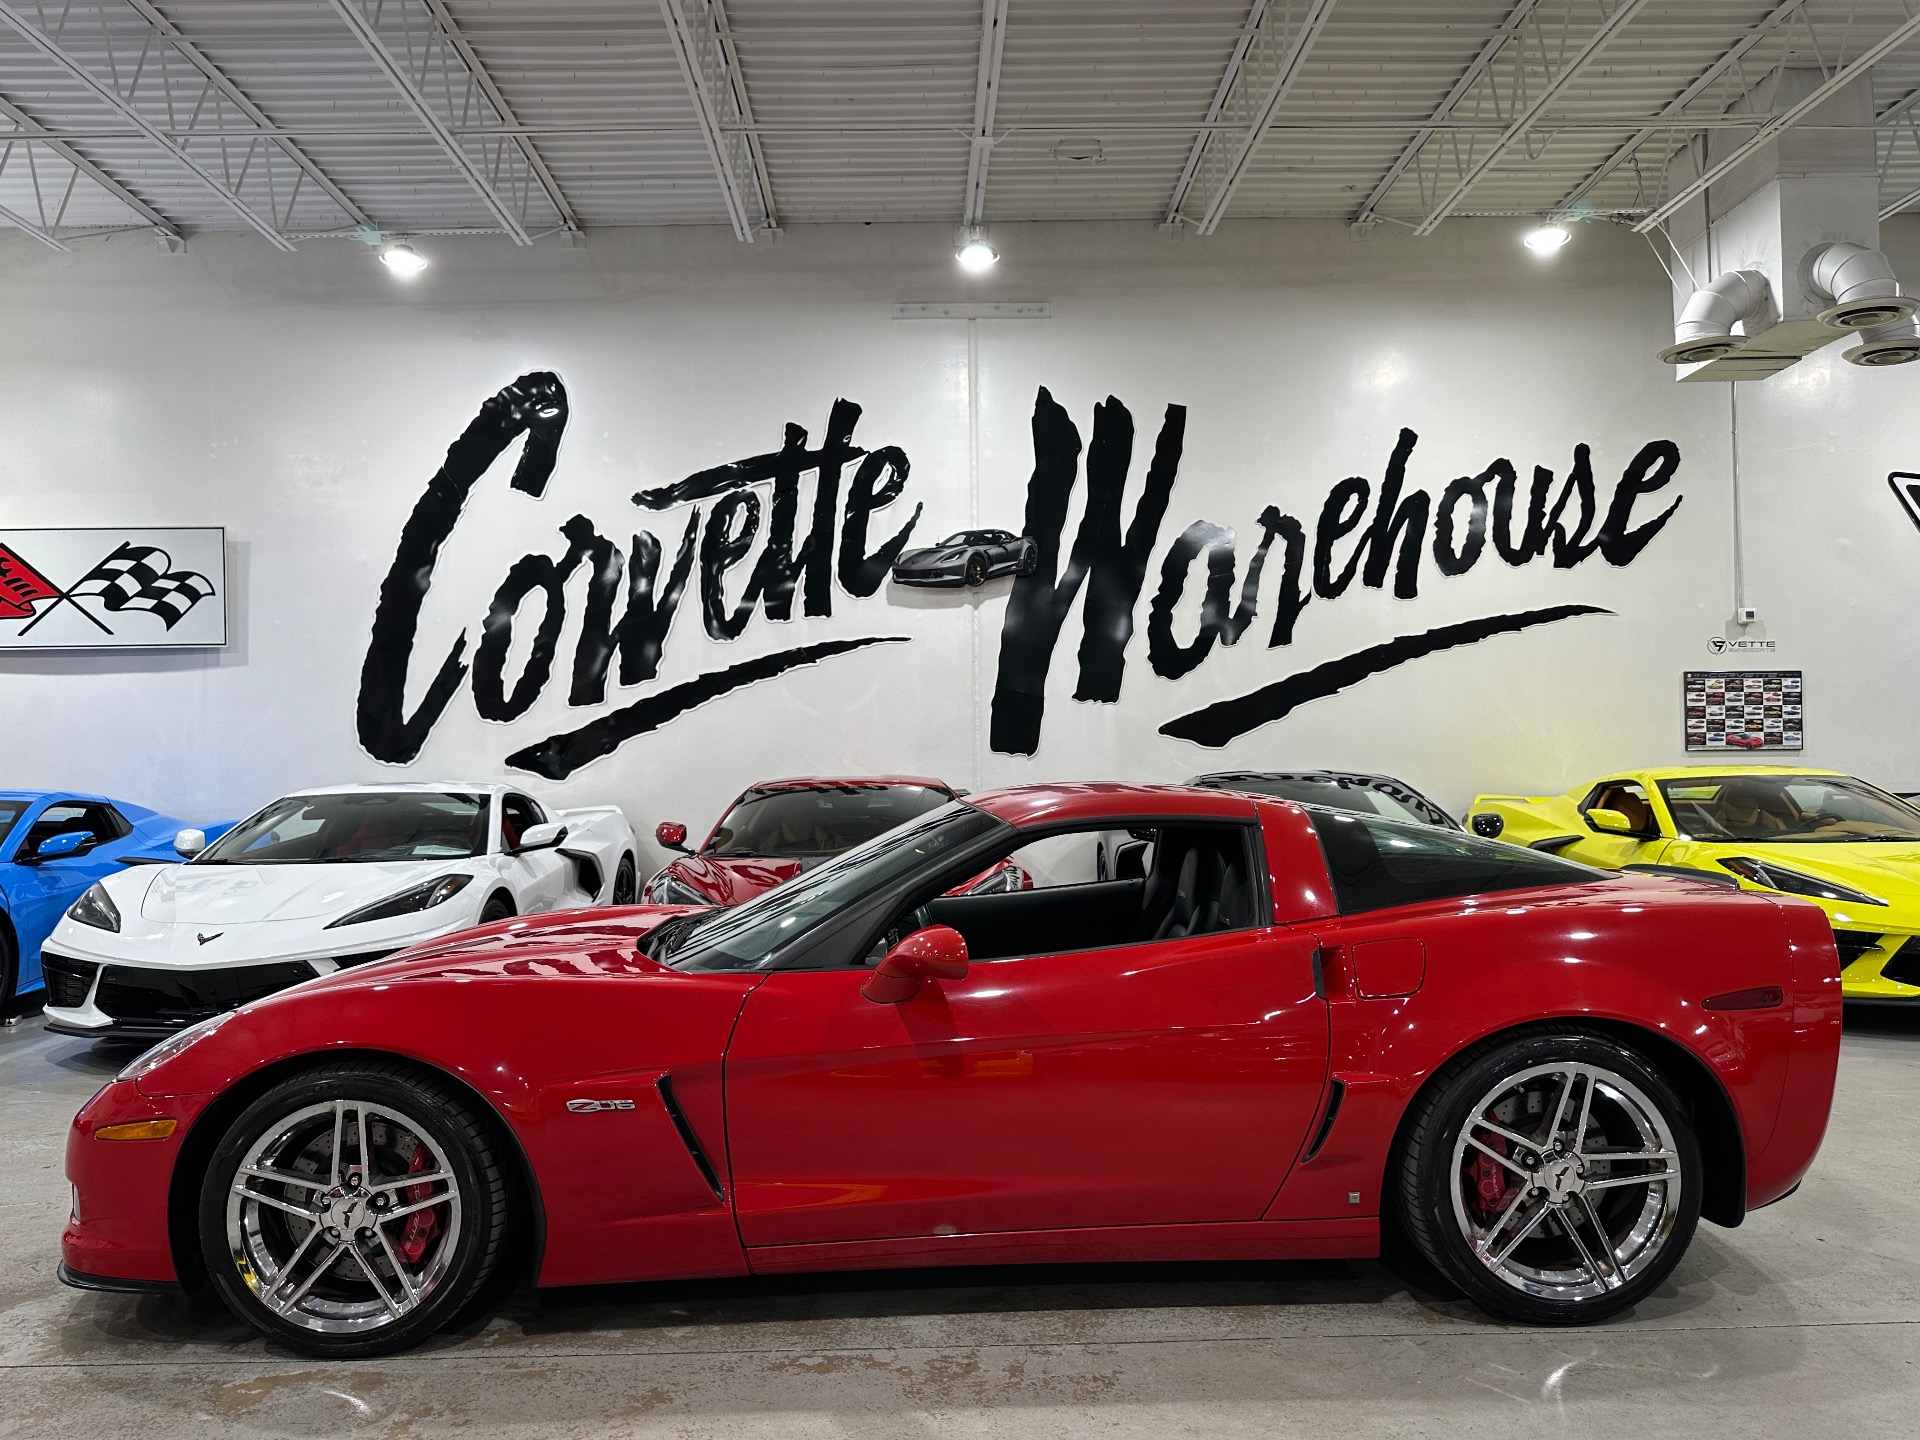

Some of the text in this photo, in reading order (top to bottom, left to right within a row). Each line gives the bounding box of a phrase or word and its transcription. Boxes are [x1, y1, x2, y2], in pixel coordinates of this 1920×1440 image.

[357, 371, 1683, 765] Corvette Warehouse
[566, 1098, 636, 1113] Z06
